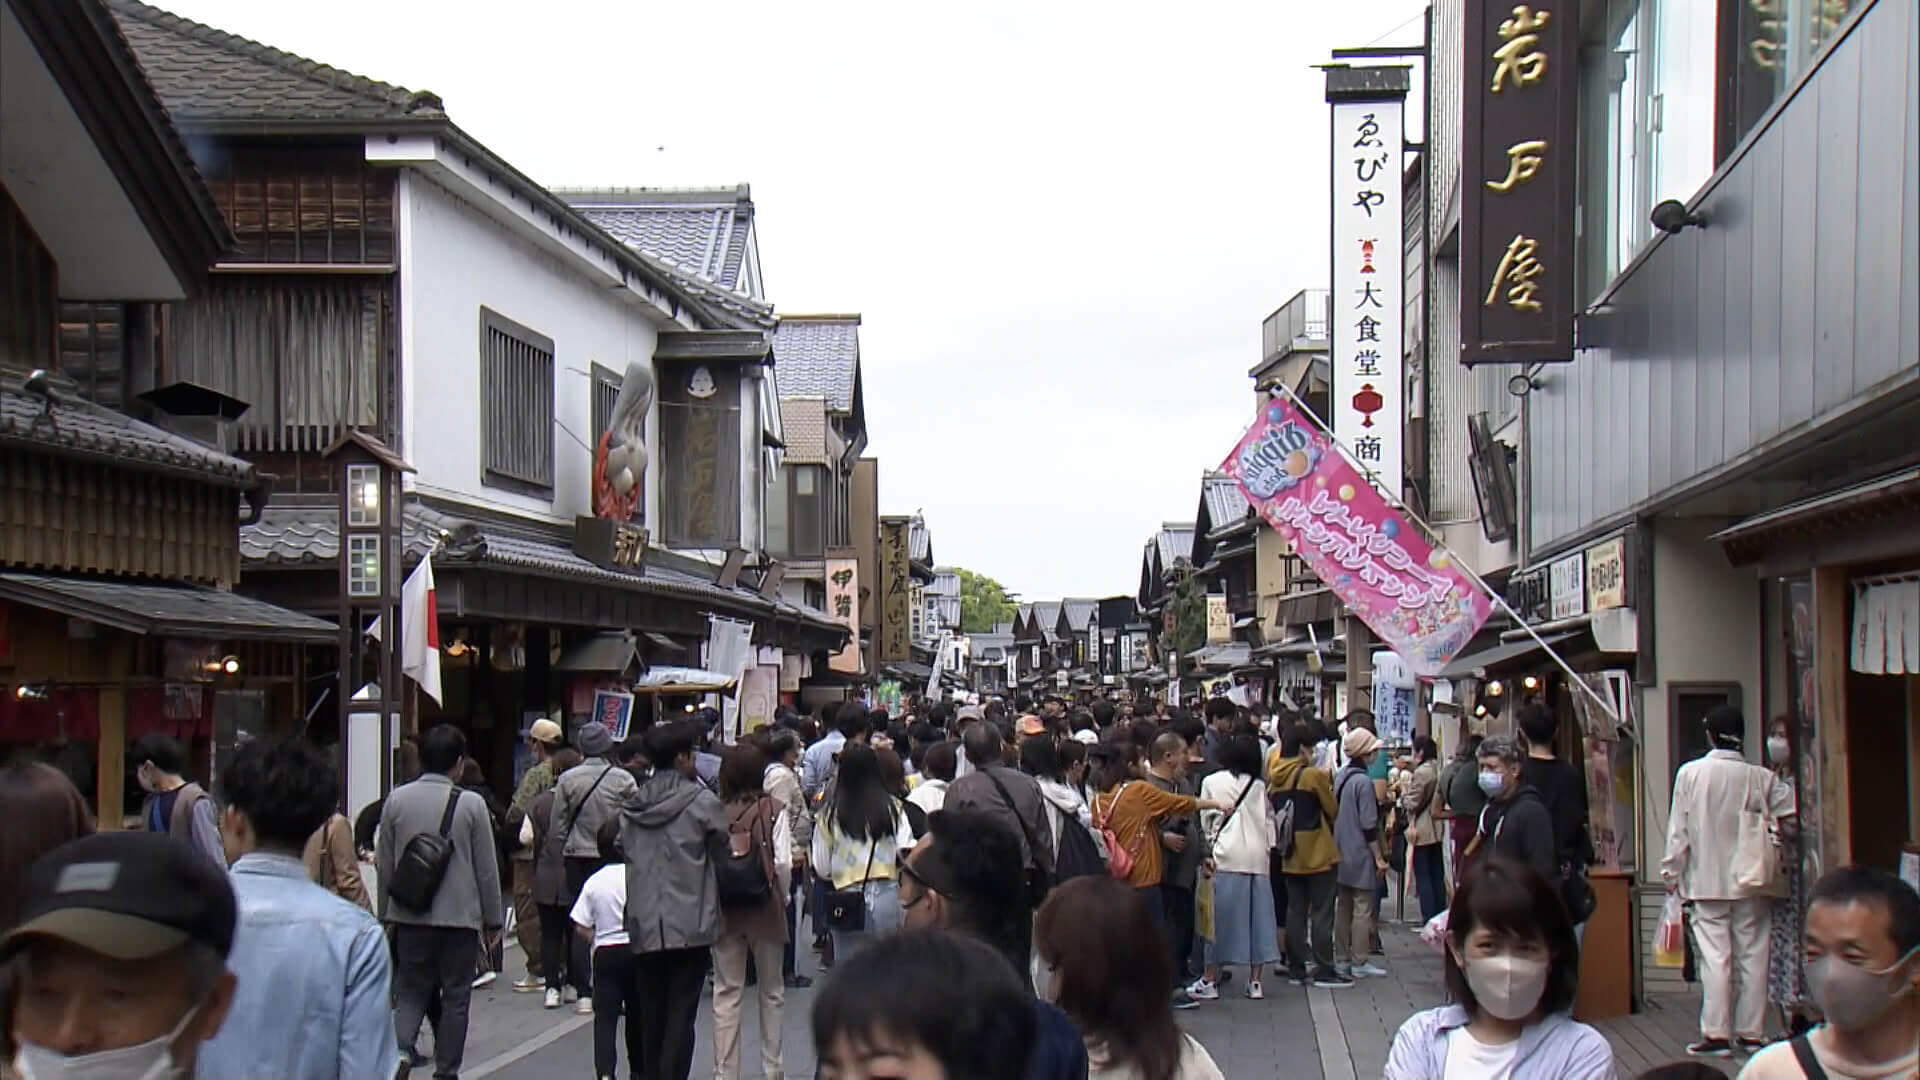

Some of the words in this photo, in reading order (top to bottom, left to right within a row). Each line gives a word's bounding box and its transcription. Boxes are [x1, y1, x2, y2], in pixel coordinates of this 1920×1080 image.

[1353, 113, 1388, 217] ゑびや
[1485, 4, 1551, 312] 岩戸屋
[1353, 281, 1383, 377] 大食堂
